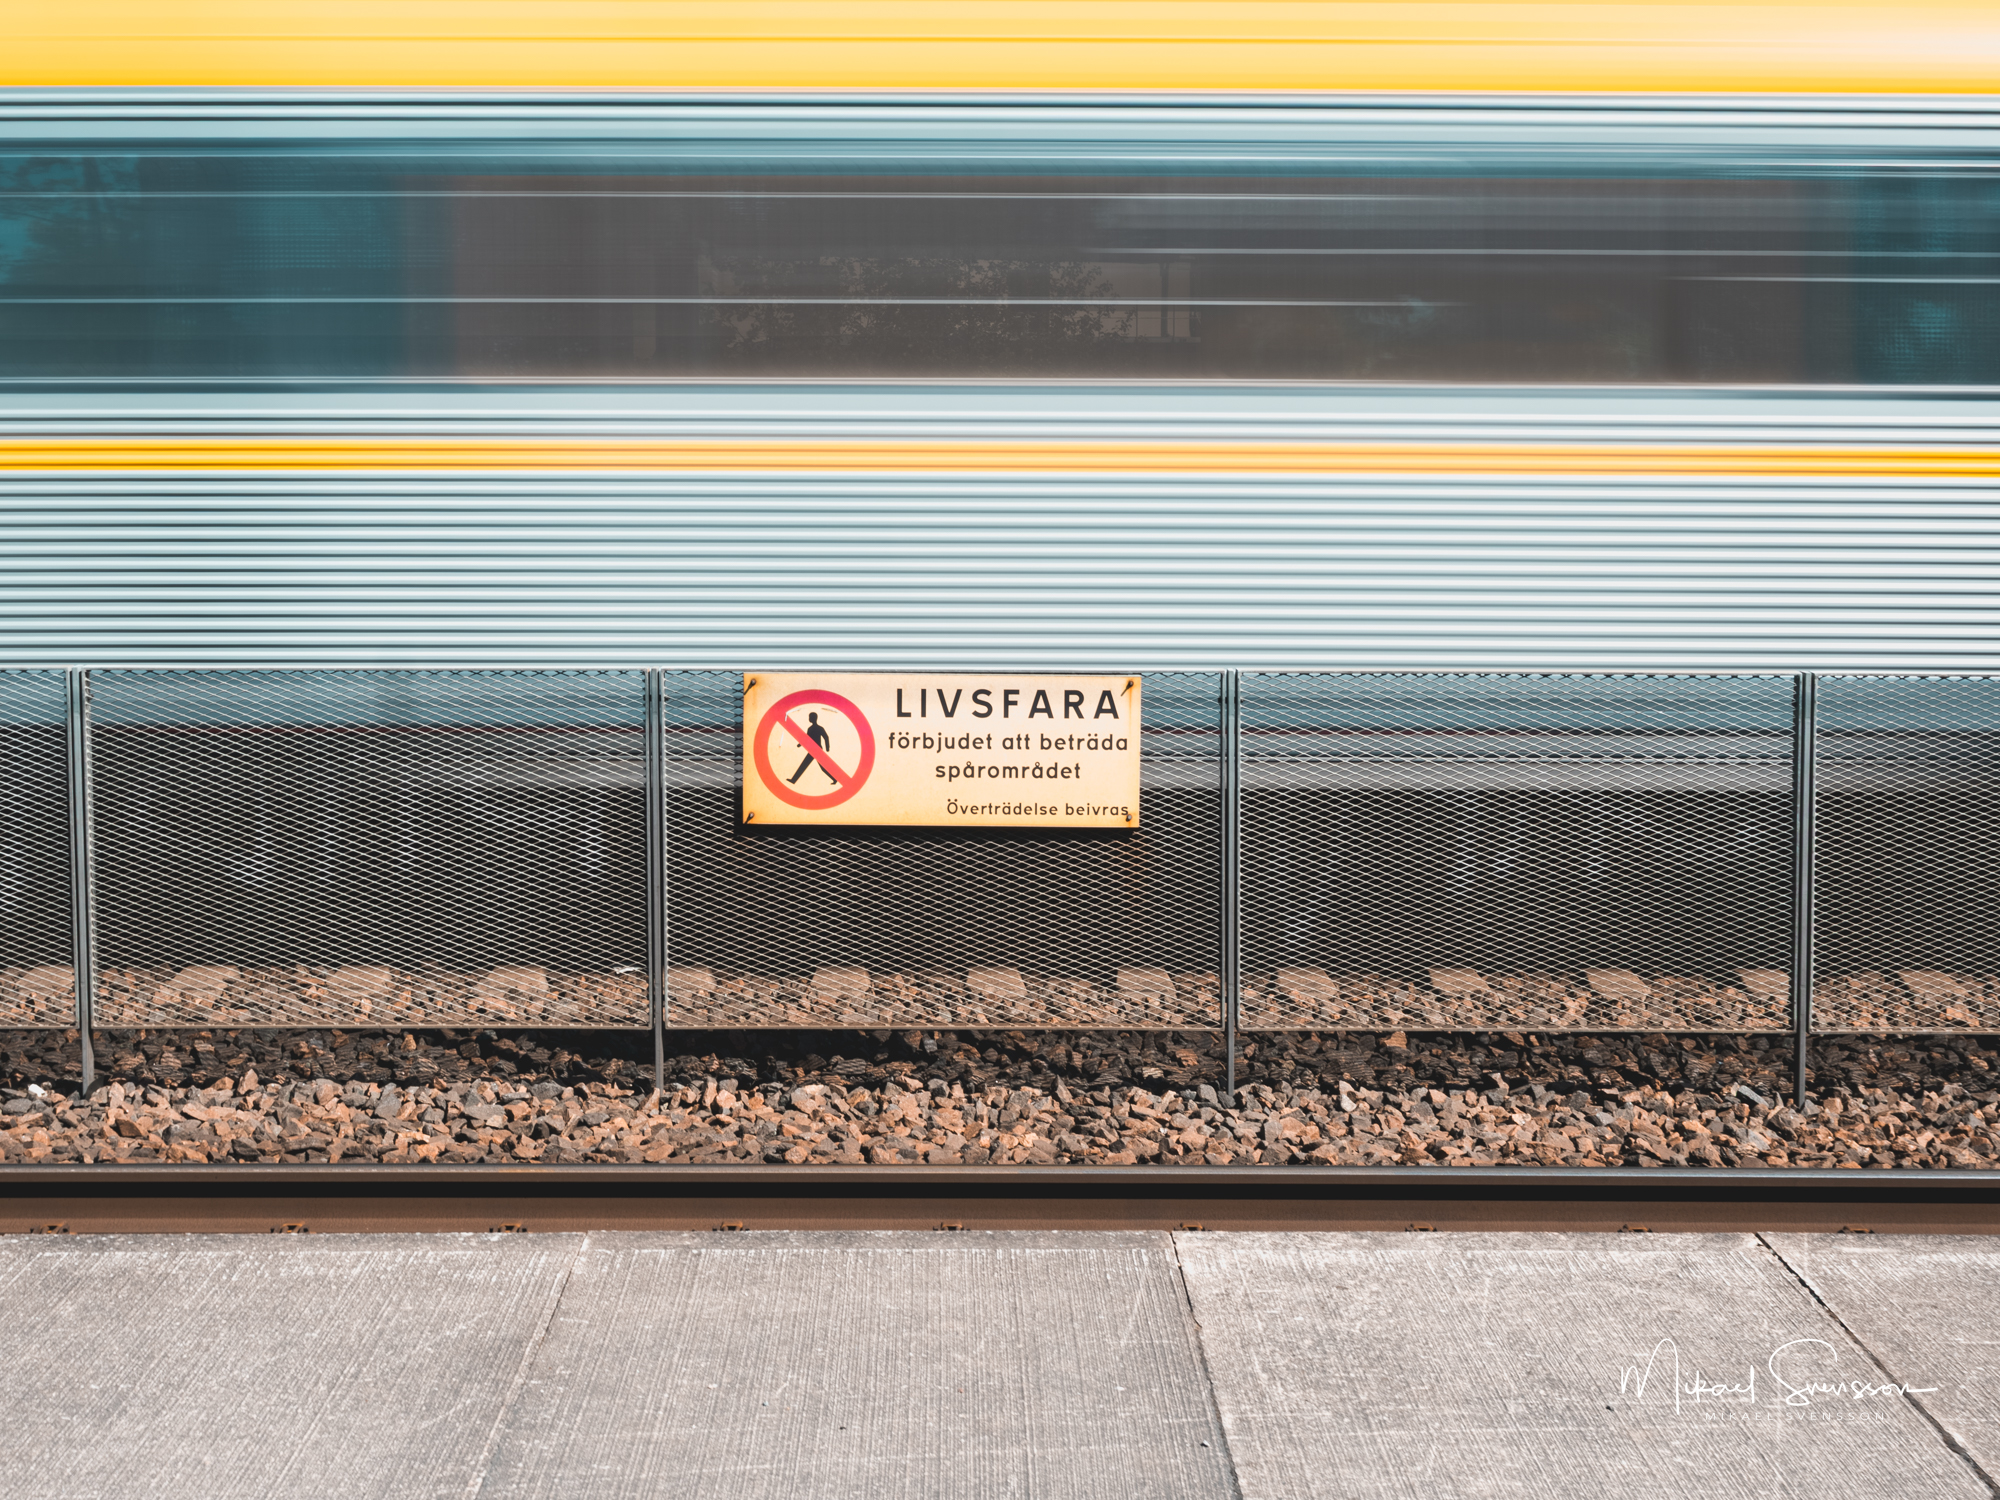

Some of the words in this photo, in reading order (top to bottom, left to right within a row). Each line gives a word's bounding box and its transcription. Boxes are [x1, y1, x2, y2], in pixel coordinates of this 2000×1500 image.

[896, 688, 1119, 719] LIVSFARA
[888, 731, 992, 754] förbjudet
[1002, 733, 1031, 750] att
[1040, 733, 1128, 751] beträda
[935, 761, 1081, 783] spårområdet
[946, 798, 1058, 816] Överträdelse
[1065, 802, 1129, 816] beivras
